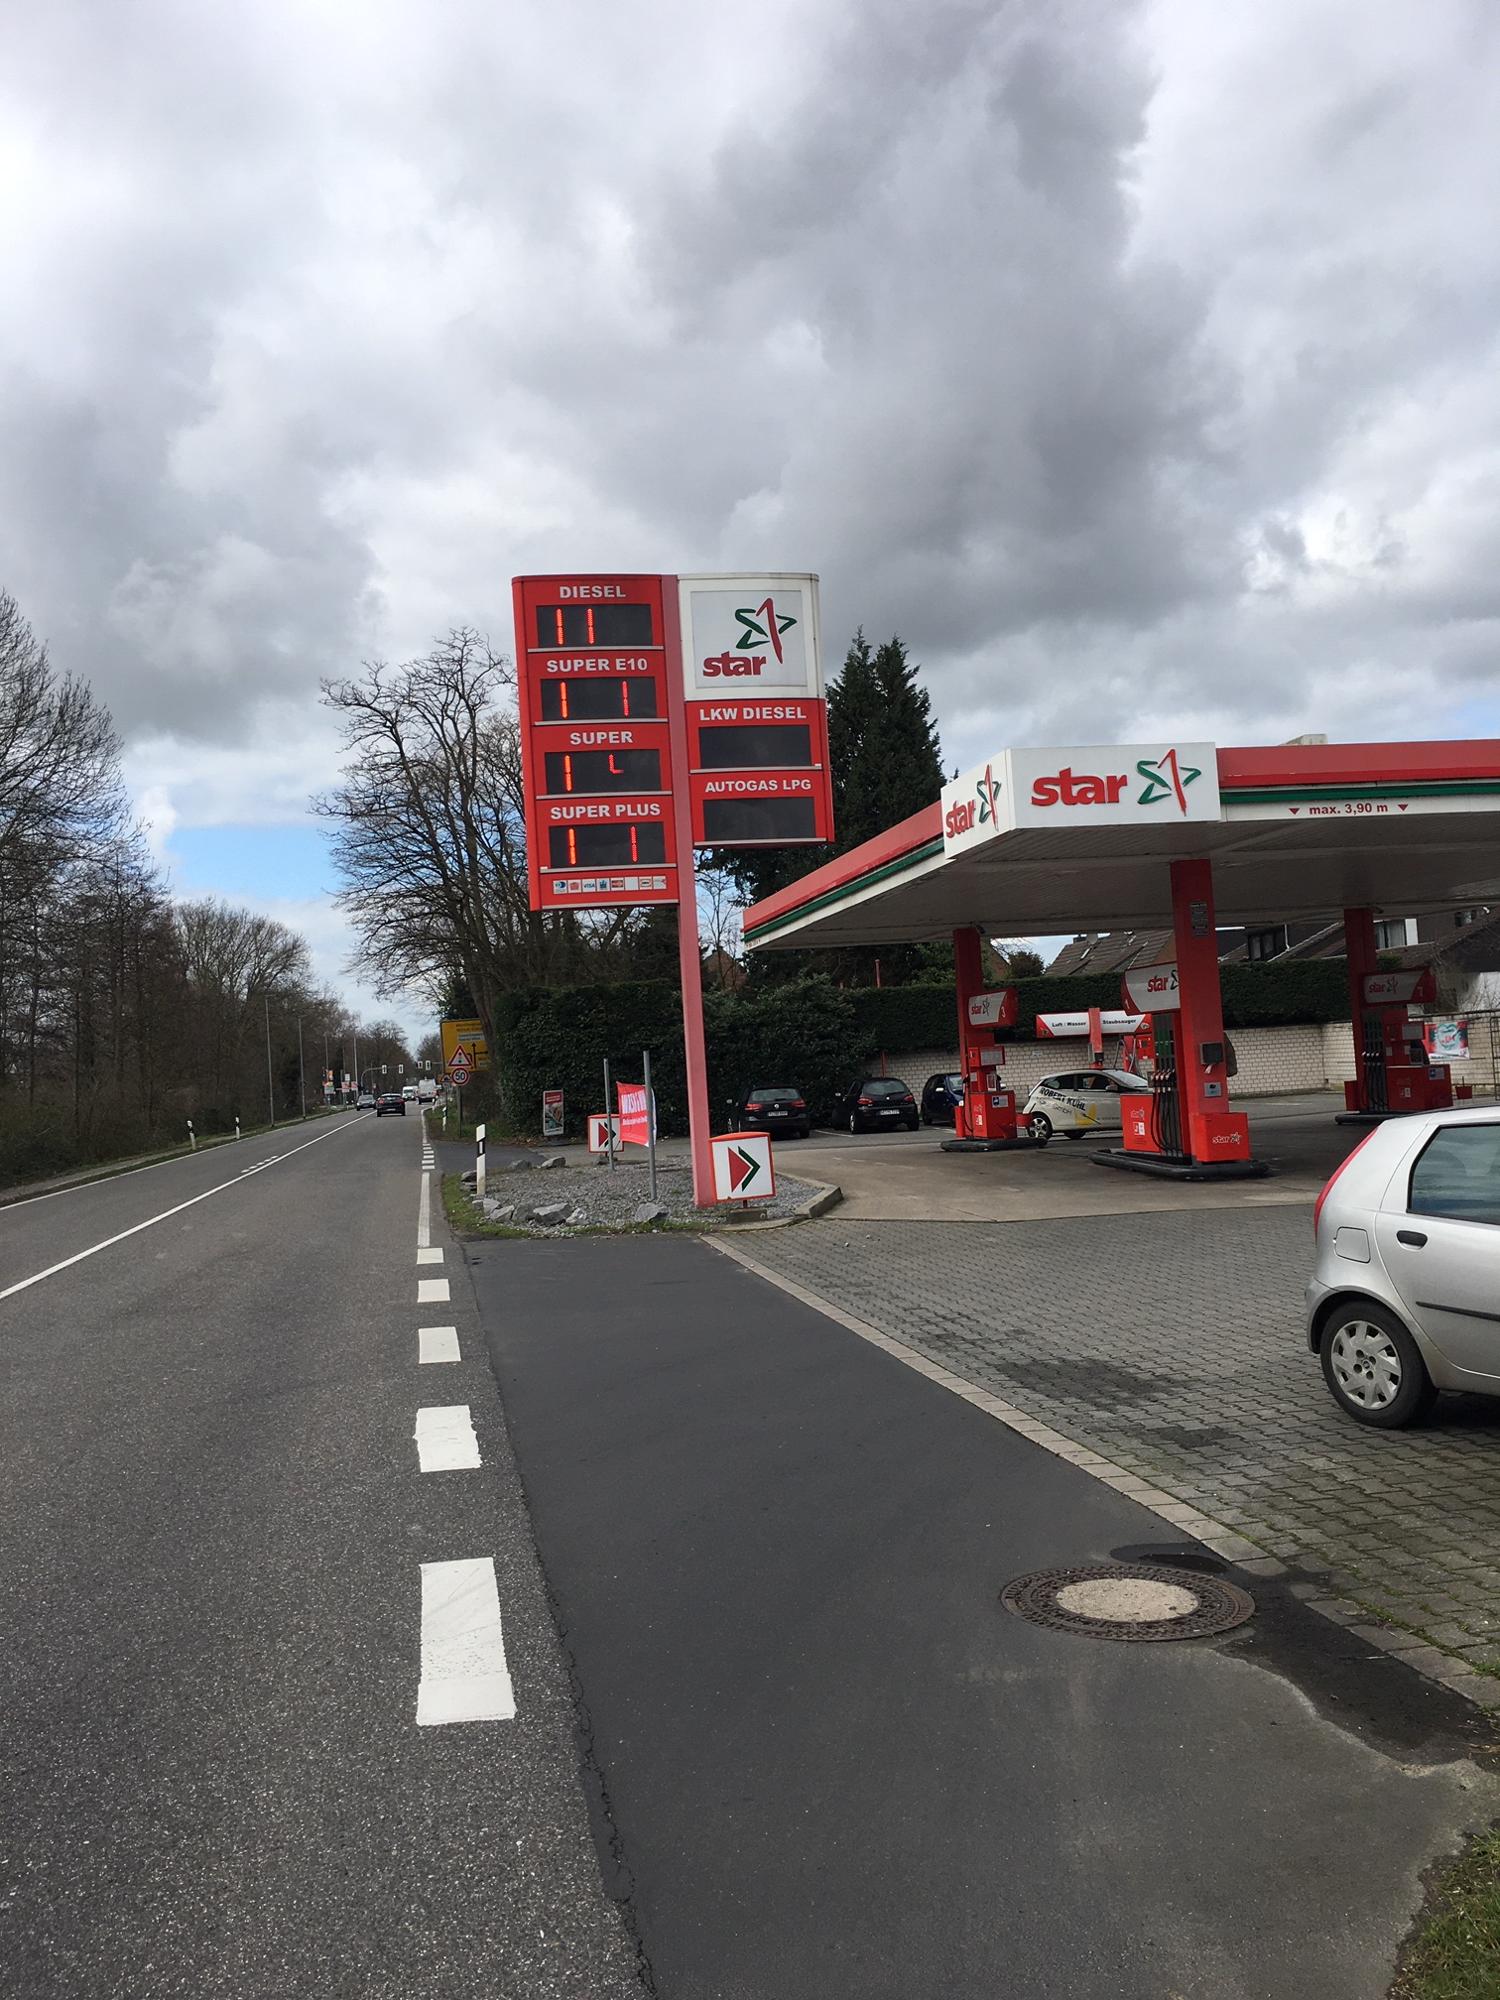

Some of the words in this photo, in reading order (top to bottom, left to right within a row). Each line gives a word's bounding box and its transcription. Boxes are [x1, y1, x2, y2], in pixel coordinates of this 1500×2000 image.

[559, 585, 626, 598] DIESEL
[546, 659, 610, 673] SUPER
[615, 658, 648, 670] E10
[703, 651, 767, 677] star
[699, 707, 738, 721] LKW
[742, 706, 807, 719] DIESEL
[570, 731, 633, 745] SUPER
[705, 781, 778, 793] AUTOGAS
[783, 779, 812, 790] LPG
[1031, 767, 1128, 806] star
[550, 804, 610, 820] SUPER
[615, 803, 661, 817] PLUS
[1309, 805, 1341, 816] max.
[1344, 802, 1373, 815] 3,90
[1376, 804, 1389, 813] m
[945, 799, 976, 839] star
[1147, 976, 1168, 992] star
[455, 1072, 466, 1081] 50
[1212, 1135, 1230, 1144] star
